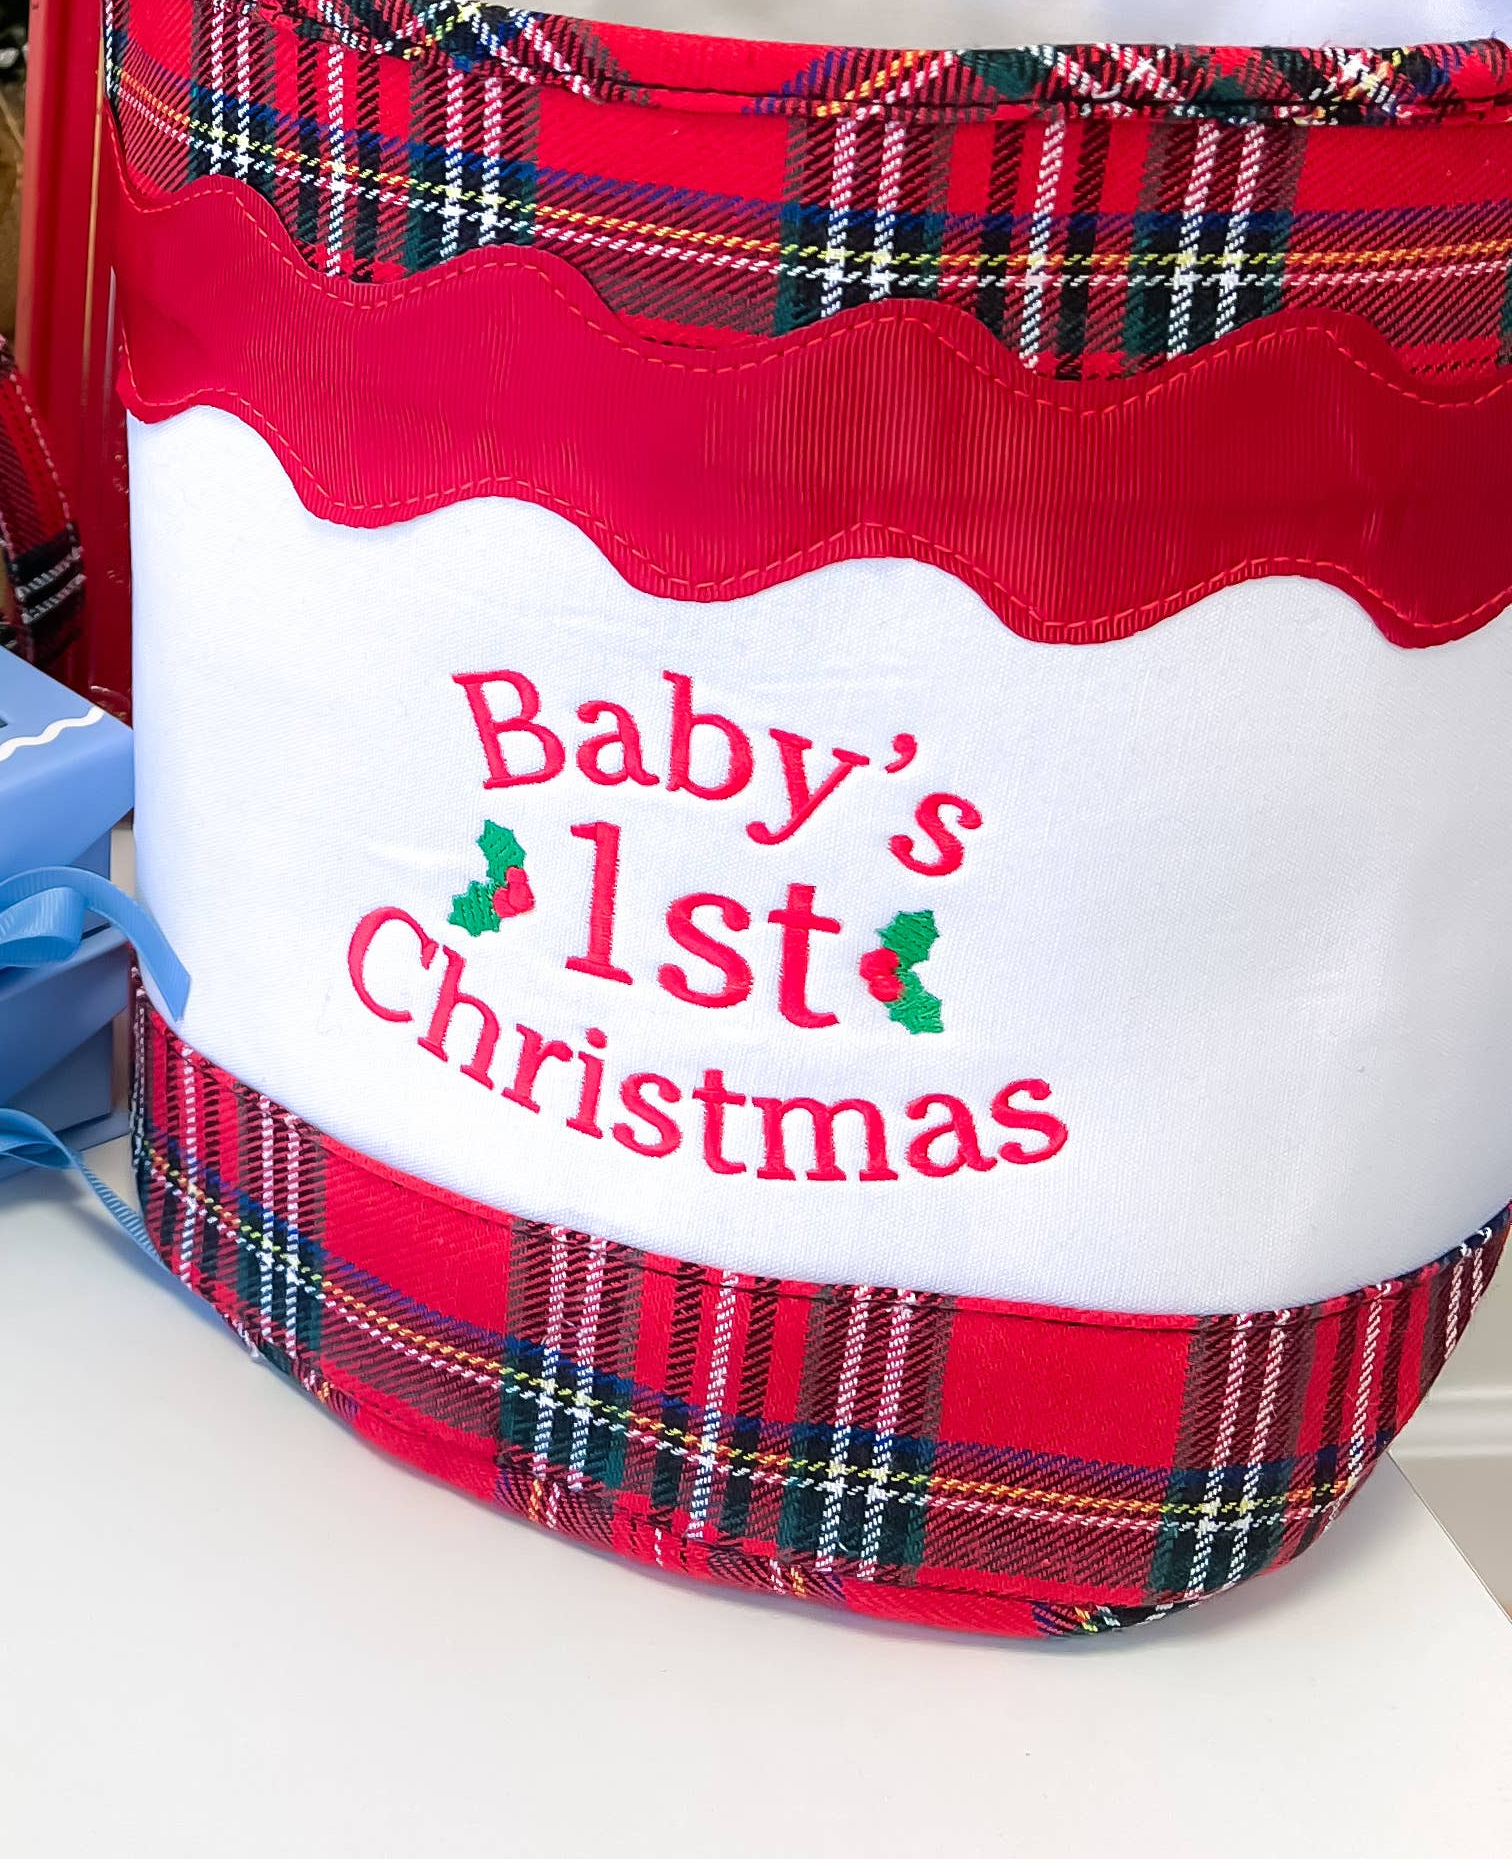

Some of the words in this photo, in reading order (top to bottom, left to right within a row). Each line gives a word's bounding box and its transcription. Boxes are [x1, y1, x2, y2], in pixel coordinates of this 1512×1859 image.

[450, 668, 983, 877] Baby's
[564, 820, 844, 1029] 1st
[347, 905, 1070, 1183] Christmas
